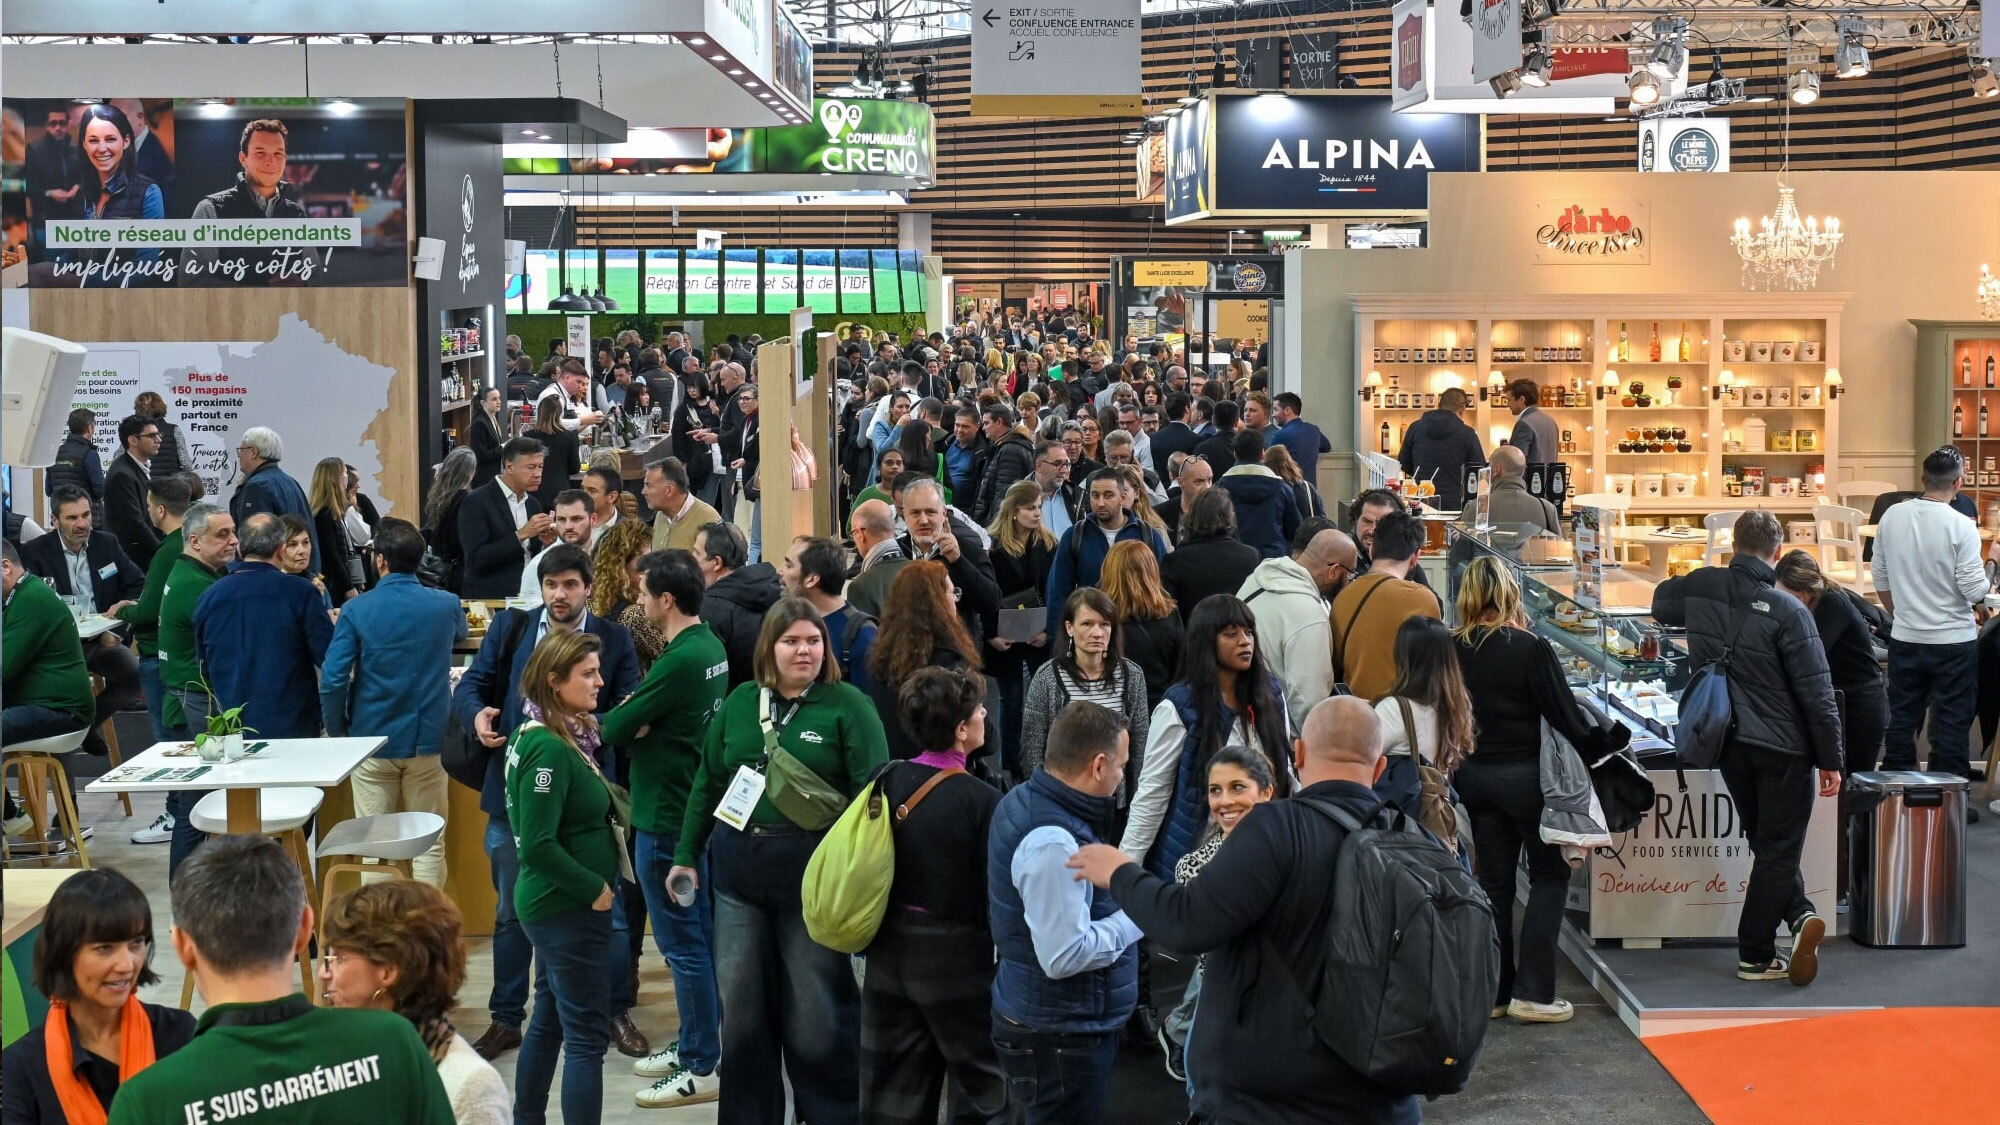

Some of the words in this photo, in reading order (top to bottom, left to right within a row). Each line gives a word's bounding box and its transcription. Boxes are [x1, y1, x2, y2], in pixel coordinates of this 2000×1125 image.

[1010, 8, 1031, 17] EXIT
[1033, 8, 1038, 17] /
[1040, 8, 1075, 17] SORTIE
[1009, 19, 1078, 28] CONFLUENCE
[1080, 19, 1135, 28] ENTRANCE
[1009, 28, 1050, 37] ACCUEIL
[1053, 28, 1118, 37] CONFLUENCE
[1293, 51, 1331, 64] SORTIE
[1301, 67, 1324, 80] EXIT
[1553, 64, 1587, 73] AMILIALE
[1261, 137, 1436, 170] ALPINA
[821, 146, 918, 174] CRENO
[1175, 145, 1197, 181] ALPINA
[1318, 173, 1352, 185] Depuis
[1355, 172, 1377, 183] 1844
[55, 225, 111, 243] Notre
[118, 225, 185, 243] réseau
[1536, 223, 1599, 255] Since
[1600, 226, 1643, 255] 1879
[53, 247, 178, 289] impliqués
[185, 251, 205, 276] à
[208, 256, 249, 280] vos
[322, 246, 334, 274] !
[1237, 270, 1264, 280] Sainte
[704, 276, 751, 290] Centre
[765, 277, 777, 290] et
[818, 276, 833, 290] de
[1240, 279, 1264, 288] Lucie
[102, 369, 118, 377] des
[188, 373, 212, 382] Plus
[215, 373, 229, 382] de
[89, 387, 122, 395] besoins
[171, 386, 192, 395] 150
[195, 386, 248, 396] magasins
[175, 398, 189, 407] de
[192, 398, 243, 409] proximité
[181, 411, 222, 421] partout
[224, 412, 238, 420] en
[98, 428, 117, 436] plus
[190, 423, 229, 432] France
[191, 443, 230, 462] Trouvez
[202, 459, 230, 471] vôtre
[1633, 845, 1665, 858] FOOD
[1672, 845, 1720, 858] SERVICE
[1727, 845, 1741, 858] BY
[1598, 871, 1699, 894] Dénicheur
[1705, 872, 1729, 893] de
[184, 1100, 208, 1125] JE
[210, 1087, 259, 1123] SUIS
[260, 1054, 381, 1110] CARRÉMENT
